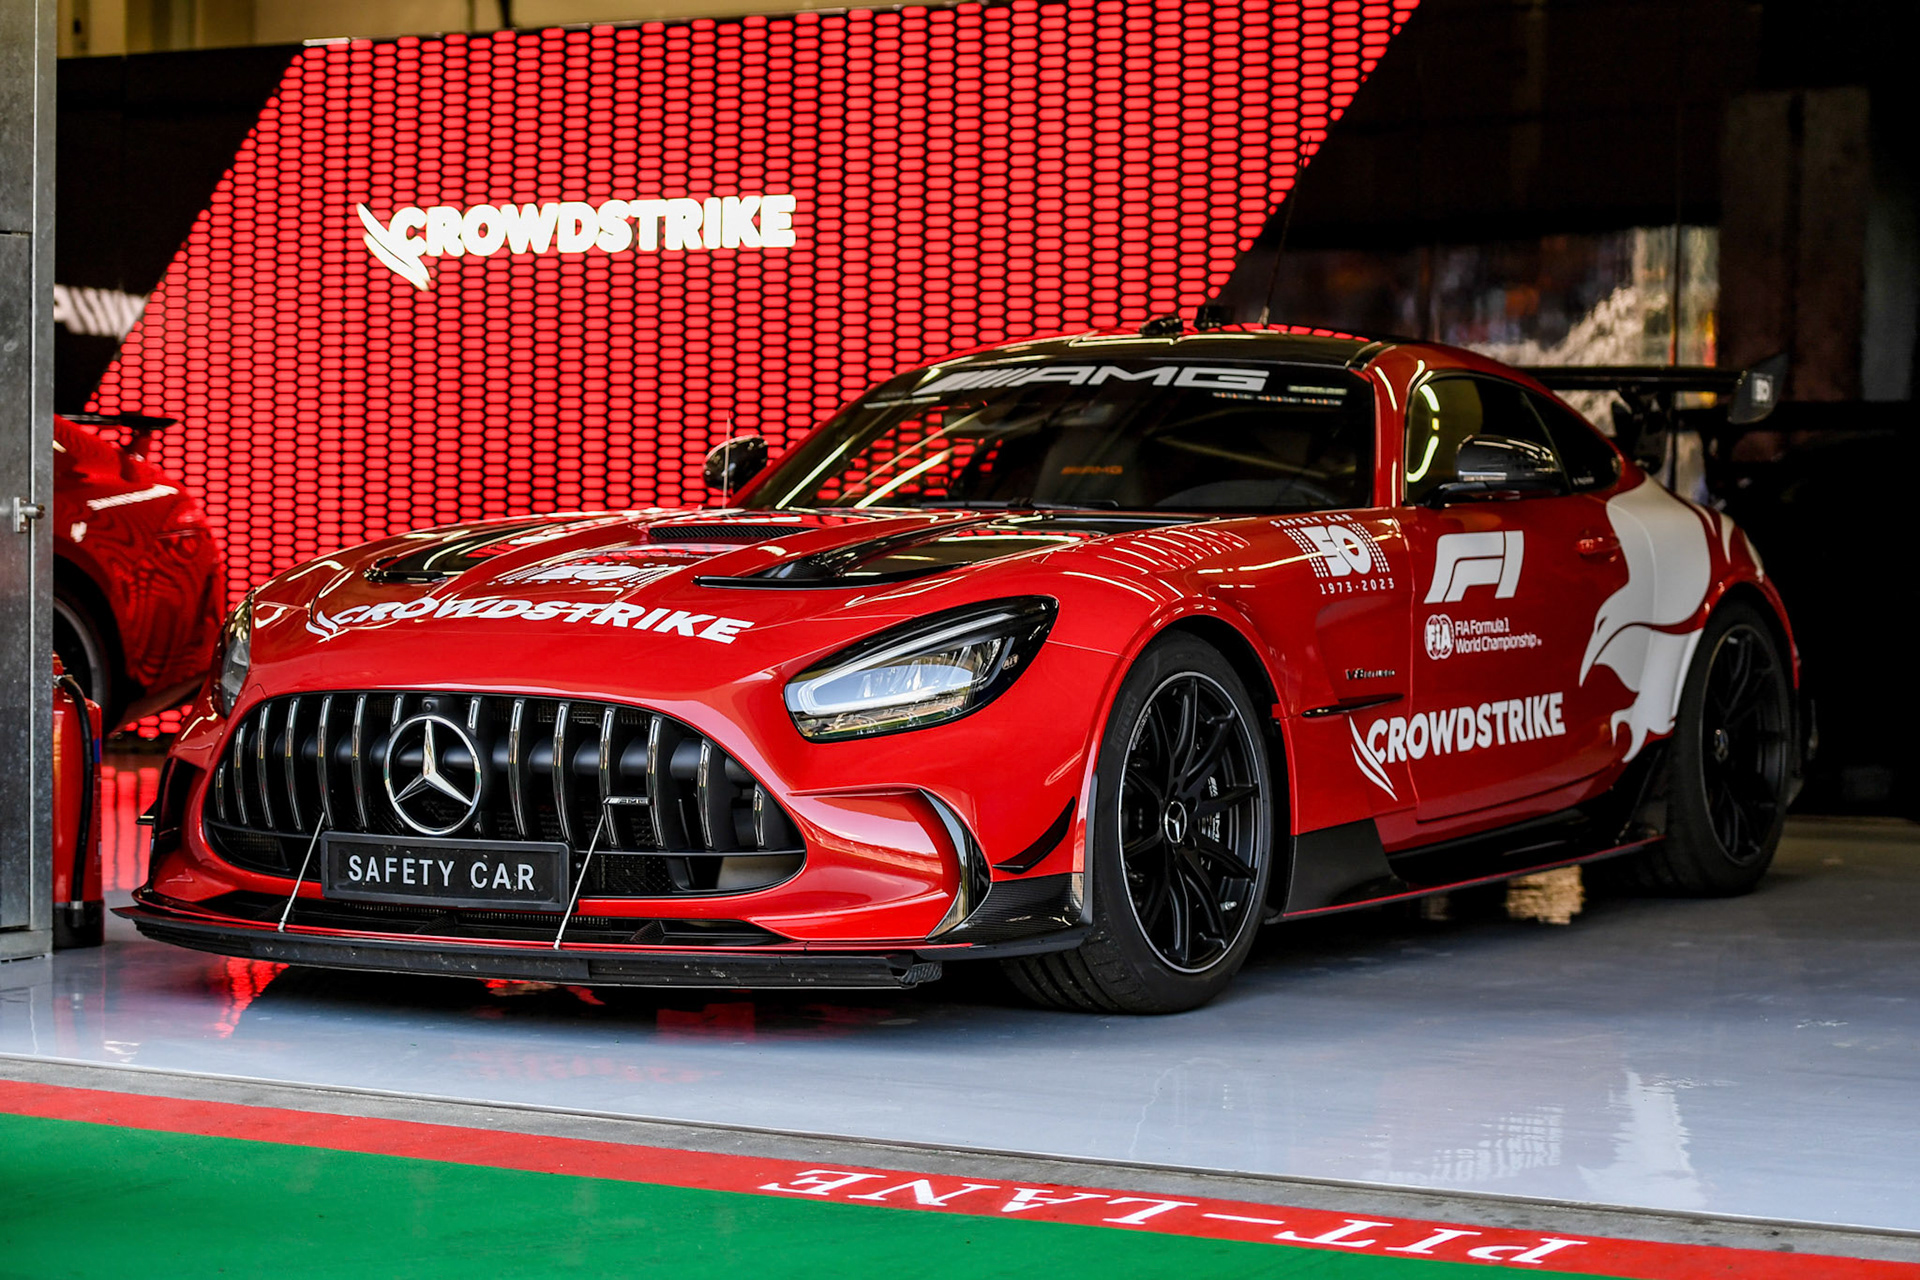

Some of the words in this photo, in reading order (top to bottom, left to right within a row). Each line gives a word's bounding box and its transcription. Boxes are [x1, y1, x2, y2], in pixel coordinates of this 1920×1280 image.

[388, 195, 797, 257] CROWDSTRIKE
[1269, 515, 1322, 528] SAFETY
[1325, 513, 1354, 523] CAR
[1299, 524, 1372, 577] 50
[1423, 530, 1524, 604] F1
[331, 596, 756, 645] CROWDSTRIKE
[1425, 623, 1453, 651] FIA
[1455, 620, 1470, 637] FIA
[1470, 619, 1504, 636] Formula
[1504, 617, 1510, 632] 1
[1455, 637, 1481, 654] World
[1481, 632, 1537, 652] Championship
[1366, 692, 1567, 765] CROWDSTRIKE
[348, 855, 455, 887] SAFETY
[470, 861, 535, 891] CAR
